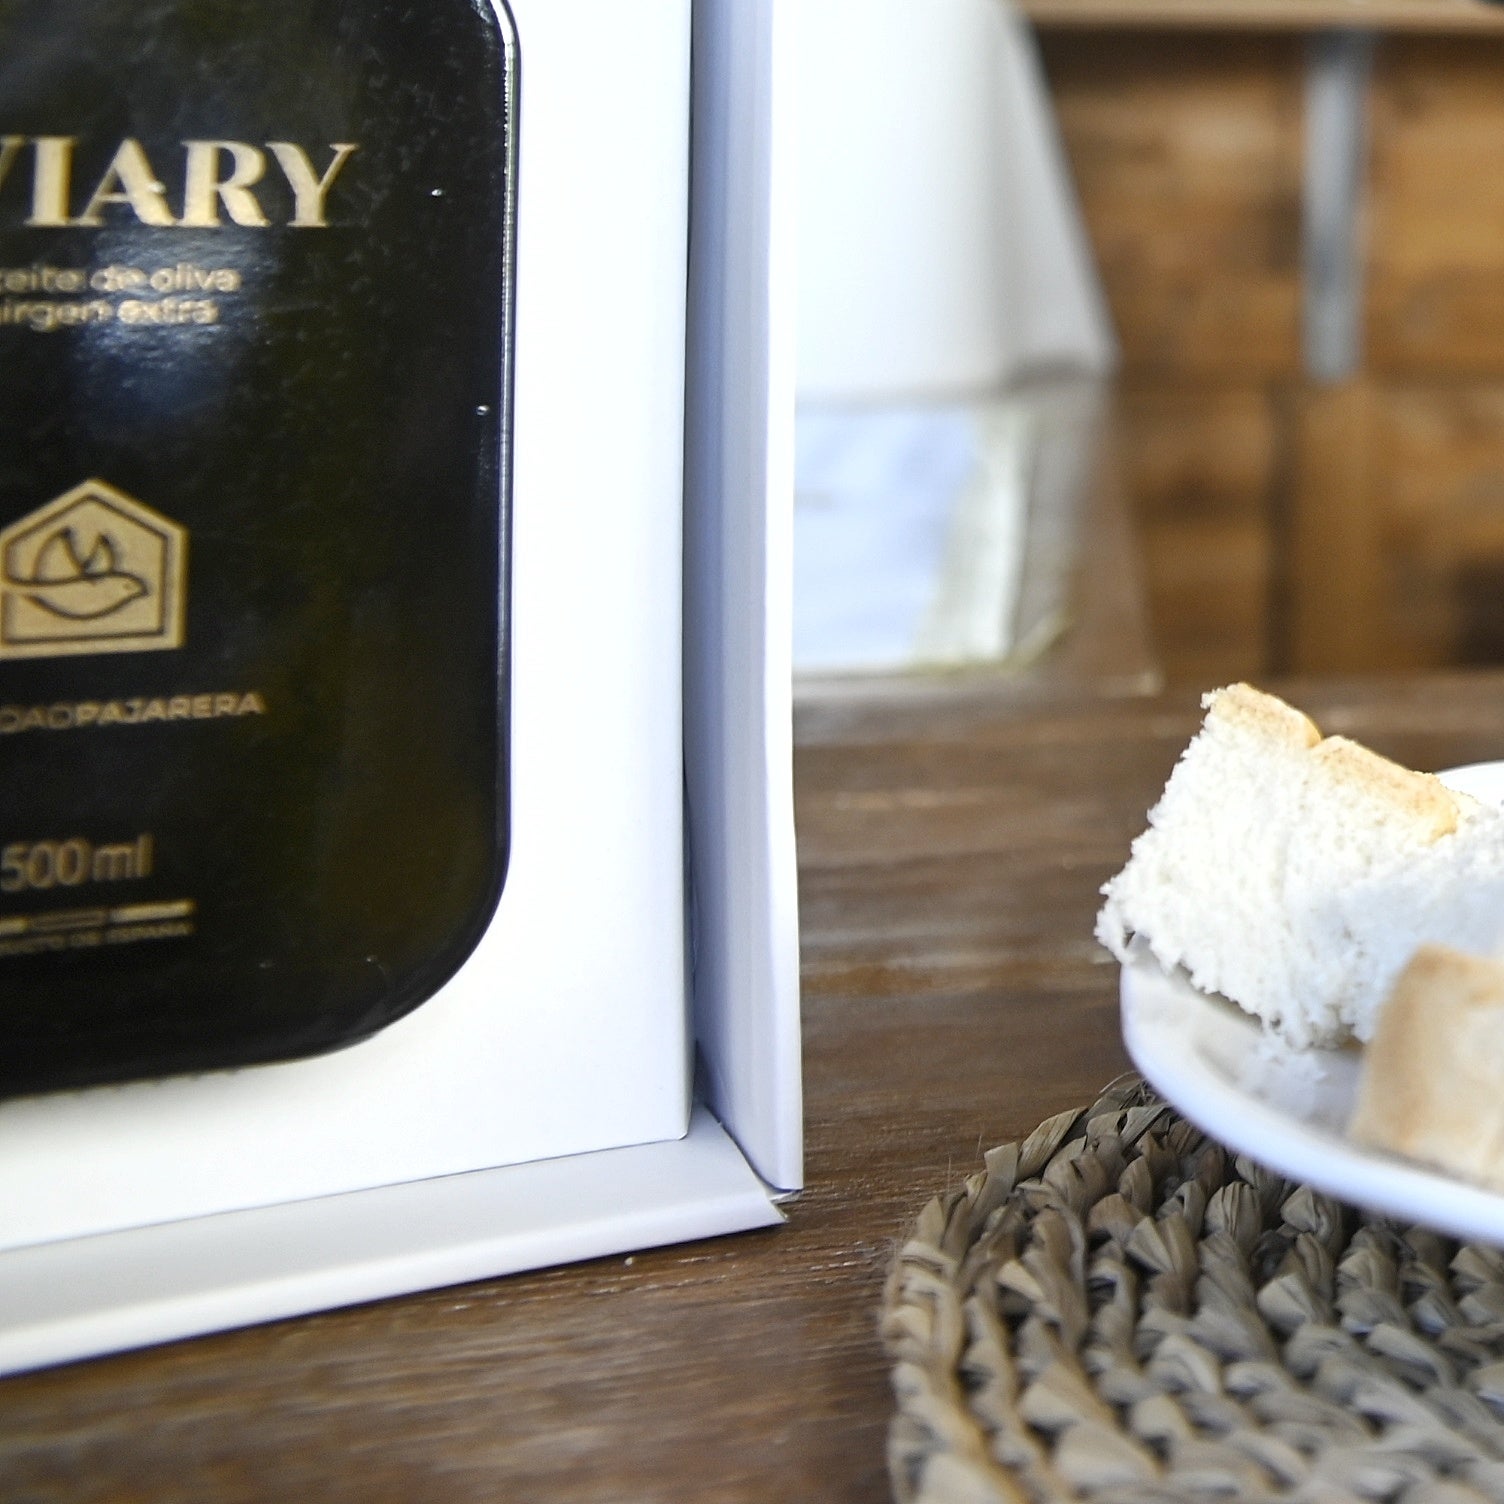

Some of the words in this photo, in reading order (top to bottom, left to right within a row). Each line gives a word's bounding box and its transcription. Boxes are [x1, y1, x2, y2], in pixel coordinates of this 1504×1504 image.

[0, 262, 86, 292] eite
[90, 263, 147, 292] de
[150, 262, 242, 293] oliva
[0, 298, 113, 332] irgen
[117, 297, 220, 325] extra
[0, 838, 91, 892] 500
[92, 832, 155, 882] ml
